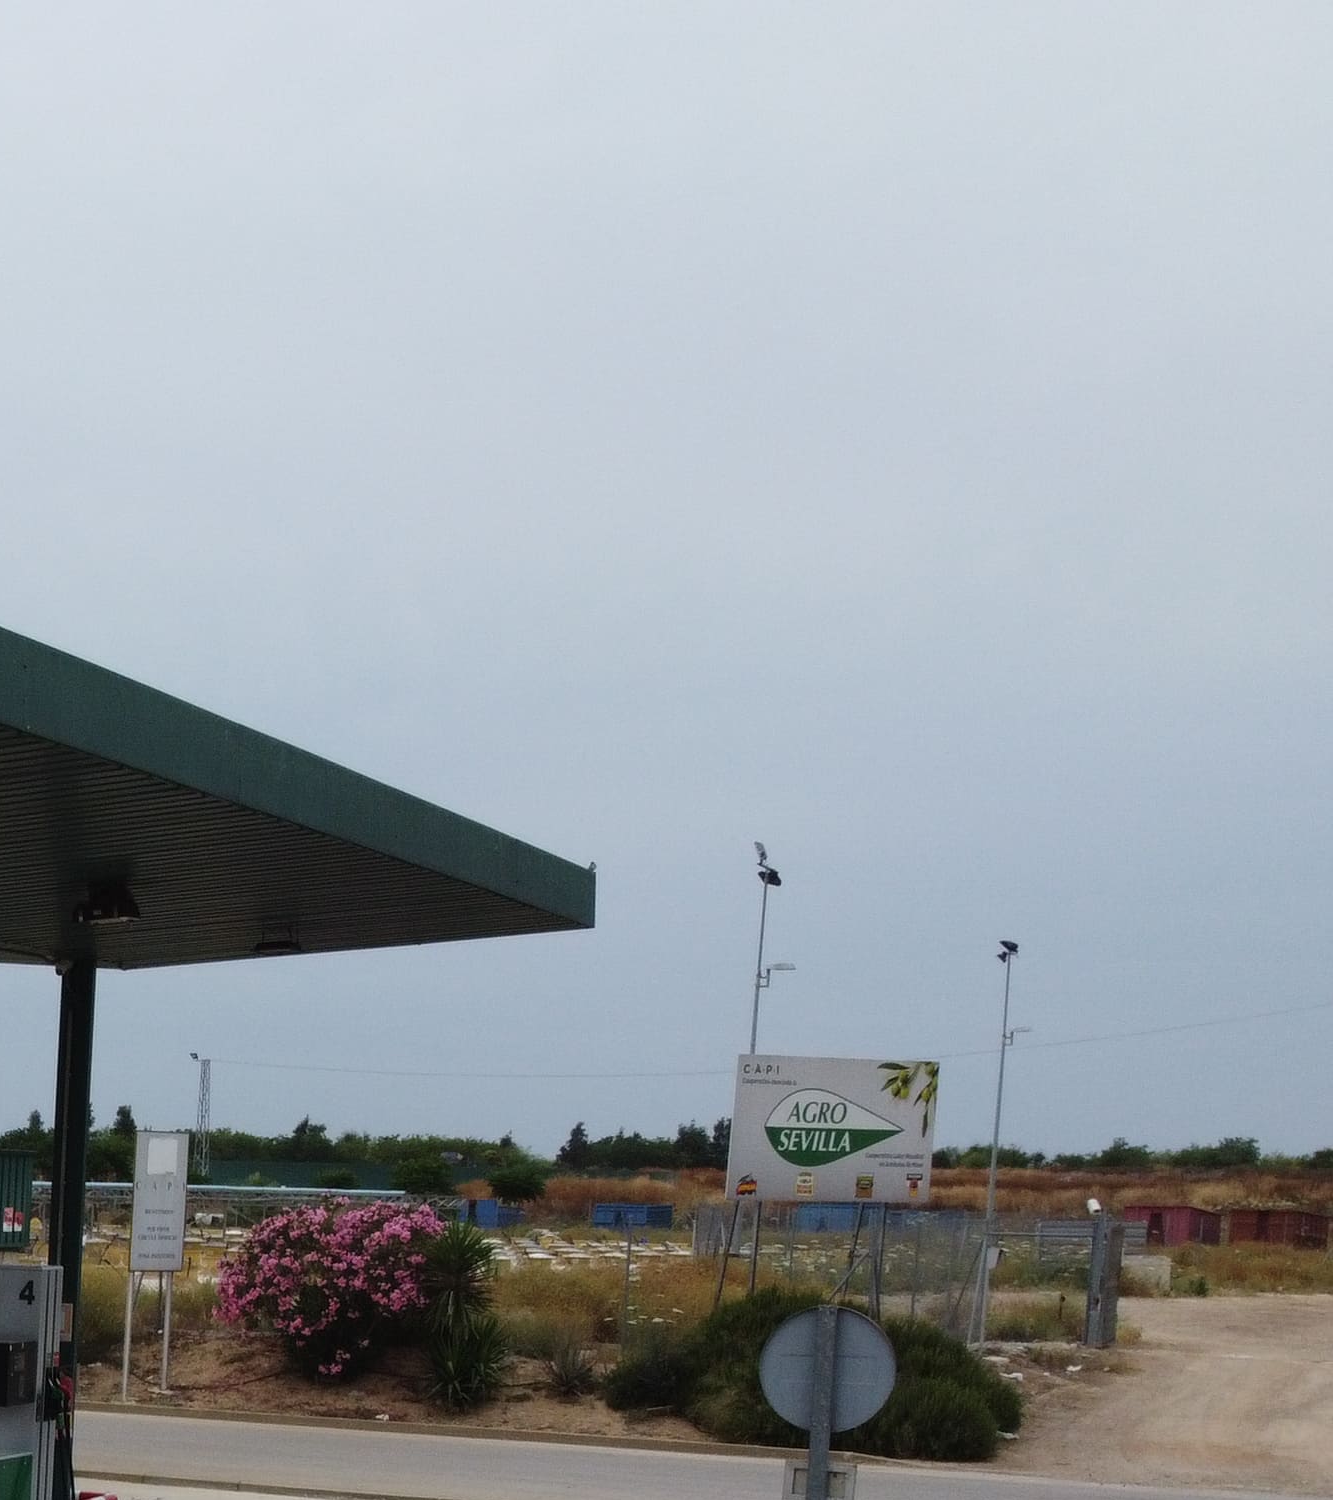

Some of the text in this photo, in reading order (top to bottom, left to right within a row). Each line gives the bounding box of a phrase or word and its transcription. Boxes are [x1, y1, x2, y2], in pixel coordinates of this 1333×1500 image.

[787, 1101, 847, 1125] AGRO
[778, 1129, 851, 1152] SEVILLA
[19, 1280, 35, 1305] 4
